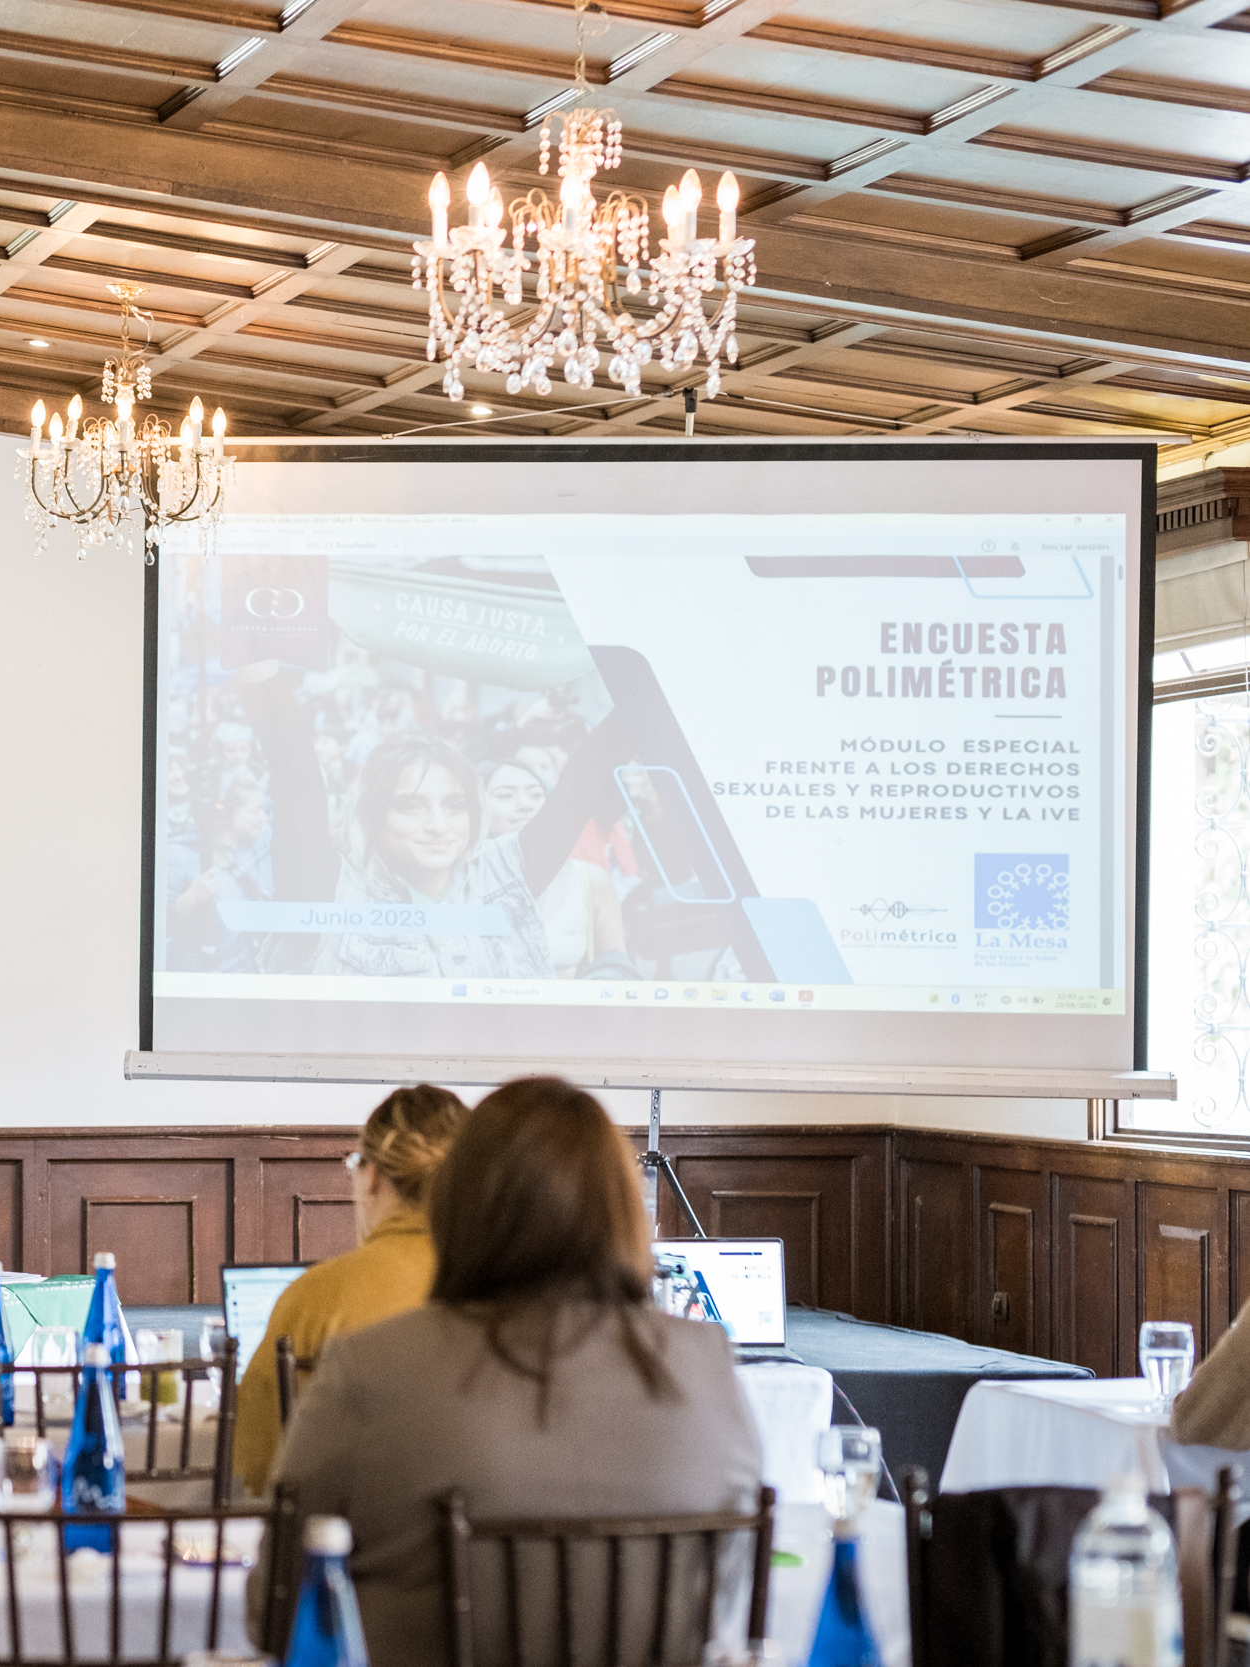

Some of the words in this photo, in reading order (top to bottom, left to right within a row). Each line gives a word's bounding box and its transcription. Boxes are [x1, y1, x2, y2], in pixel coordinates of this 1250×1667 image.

[395, 592, 468, 622] CAUSA
[475, 605, 545, 637] JUSTA
[393, 621, 430, 643] POR
[436, 628, 459, 647] EL
[463, 632, 540, 661] ABORTO
[880, 622, 1067, 655] ENCUESTA
[816, 659, 1067, 699] POLIMÉTRICA
[840, 736, 946, 754] MÓDULO
[963, 739, 1081, 754] ESPECIAL
[765, 761, 856, 775] FRENTE
[865, 761, 880, 775] A
[890, 762, 937, 776] LOS
[946, 762, 1081, 777] DERECHOS
[713, 782, 836, 797] SEXUALES
[846, 783, 860, 797] Y
[870, 783, 1081, 799] REPRODUCTIVOS
[765, 805, 796, 819] DE
[805, 805, 850, 819] LAS
[859, 806, 968, 820] MUJERES
[978, 806, 992, 820] Y
[1002, 807, 1031, 820] LA
[1041, 807, 1081, 821] IVE
[300, 907, 363, 927] Junio
[370, 909, 427, 928] 2023
[840, 929, 957, 942] Polimétrica
[976, 932, 1000, 947] La
[1009, 932, 1068, 949] Mesa
